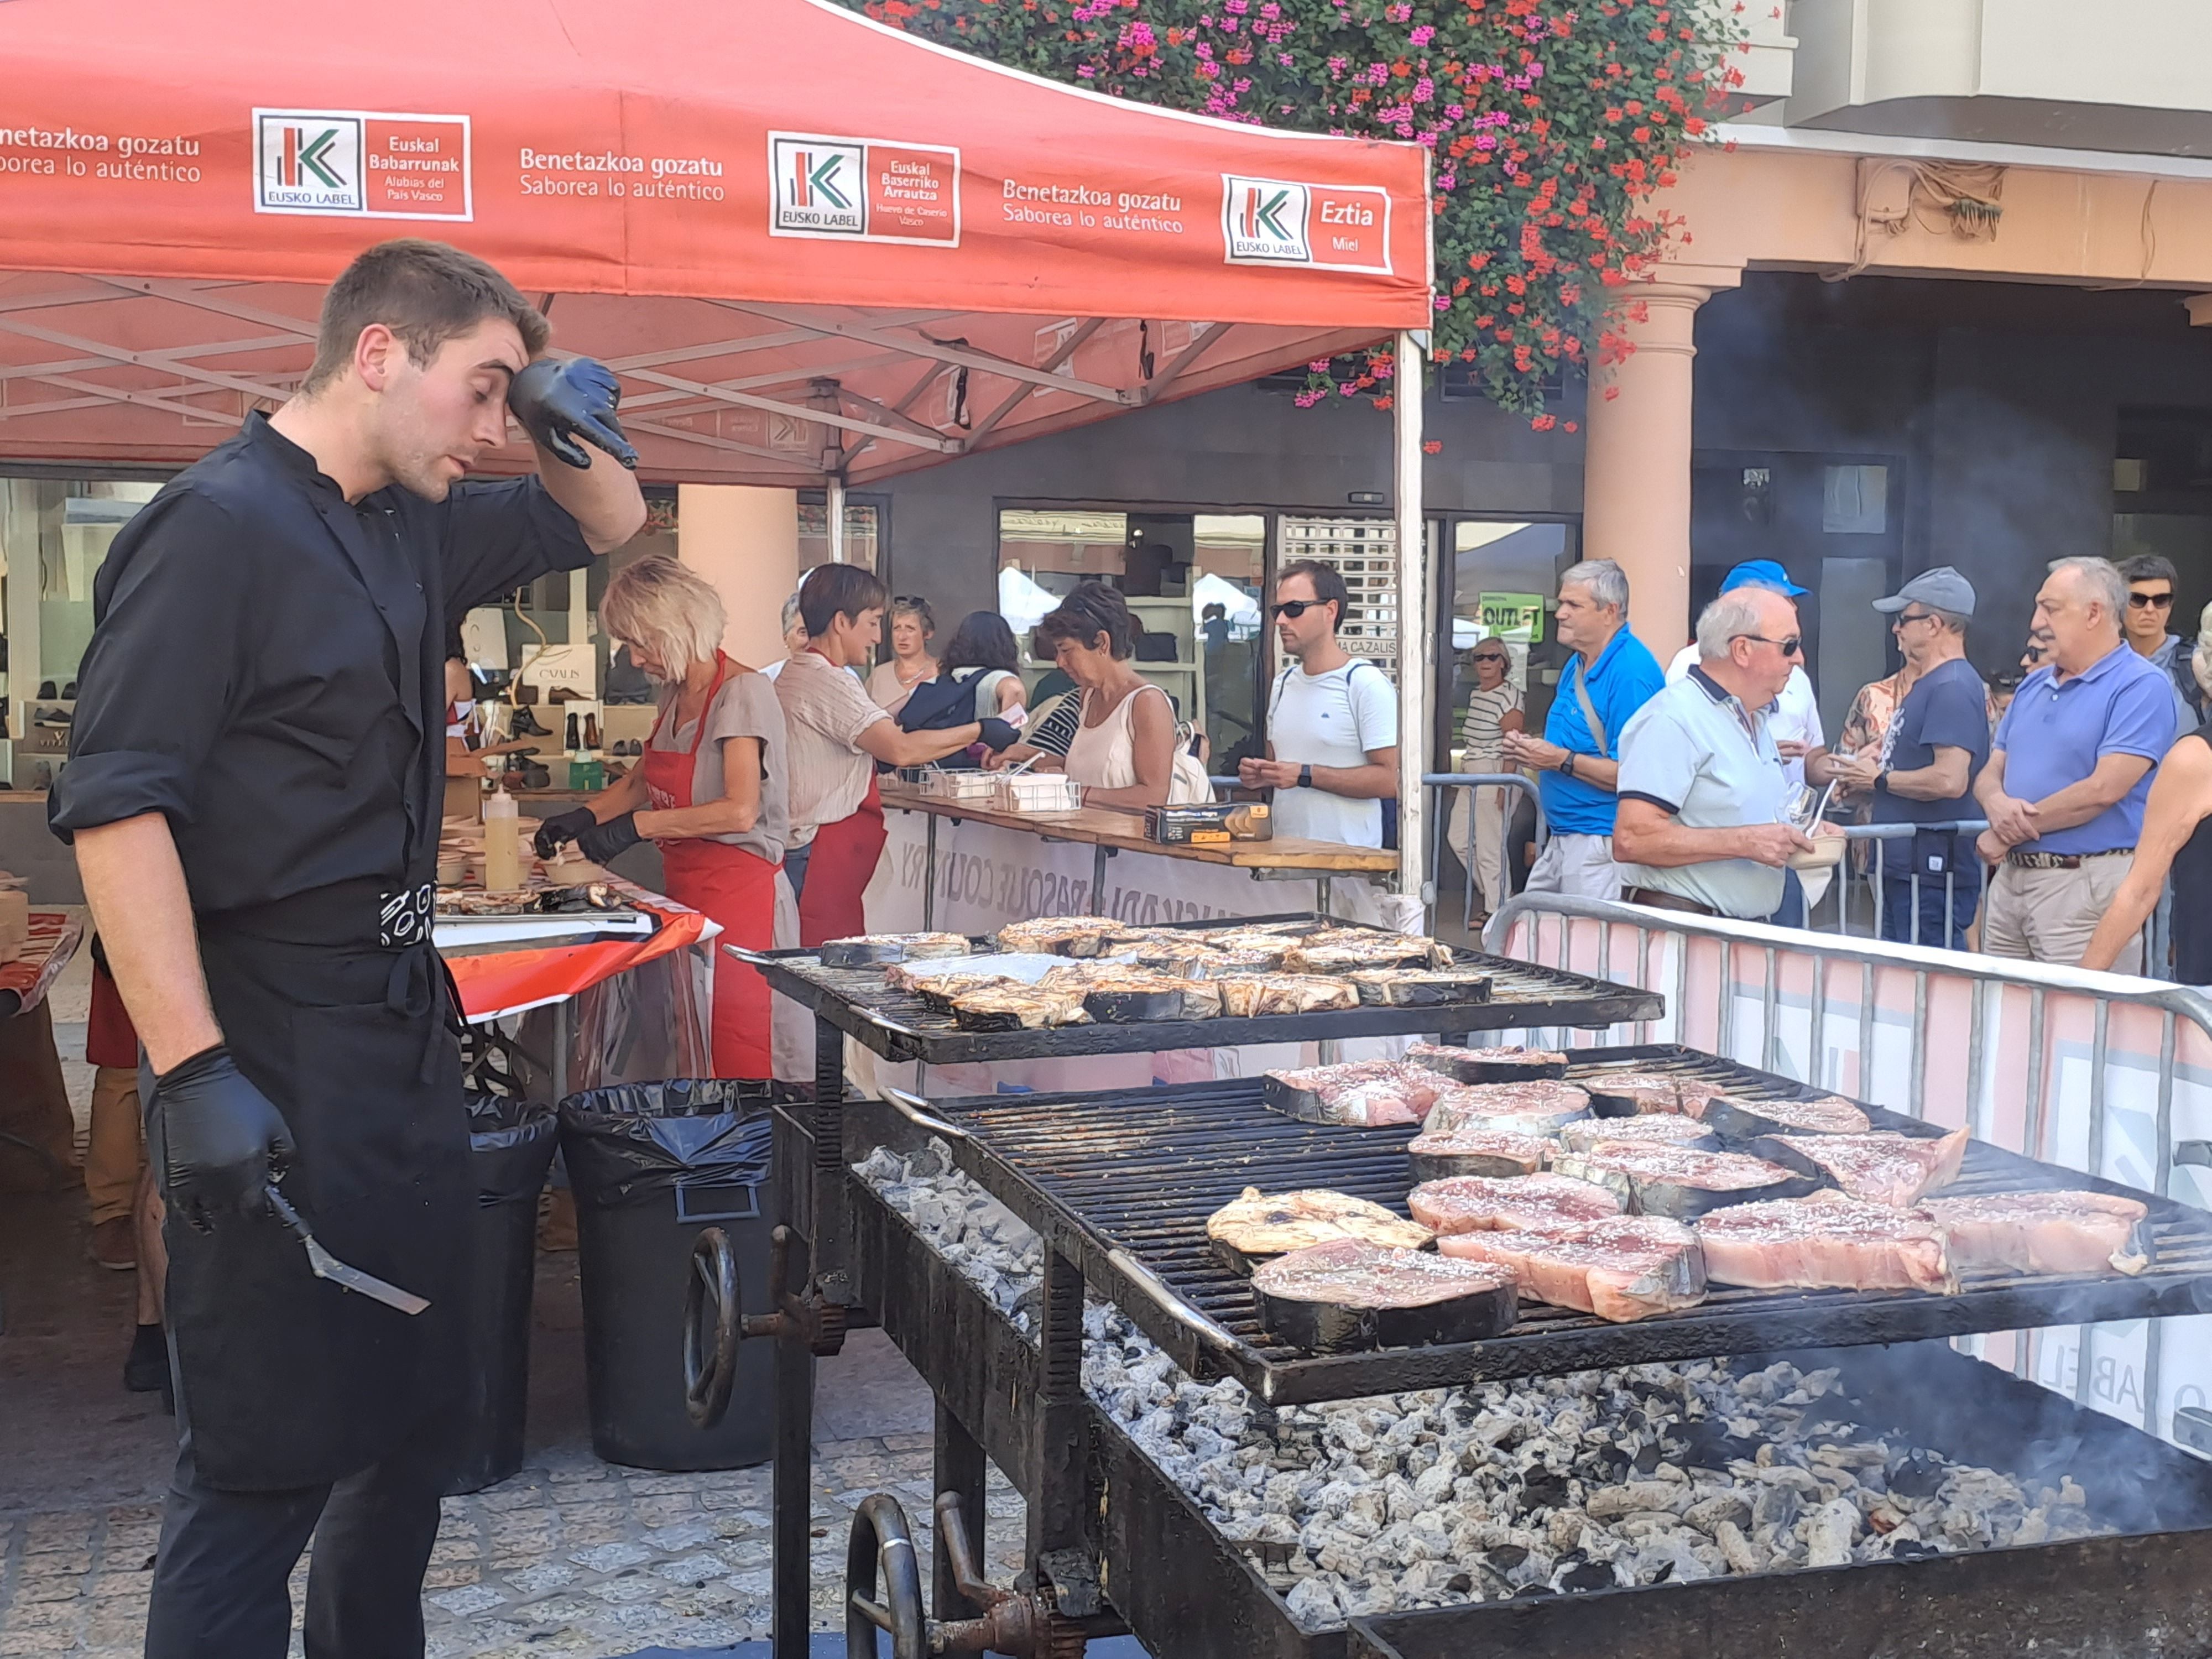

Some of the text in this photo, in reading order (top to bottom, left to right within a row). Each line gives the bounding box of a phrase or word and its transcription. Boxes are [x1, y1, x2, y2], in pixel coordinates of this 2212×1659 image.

[118, 135, 200, 159] gozatu
[389, 136, 439, 153] Euskal
[66, 155, 86, 176] lo
[96, 159, 201, 182] auténtico
[369, 154, 460, 173] Babarrunak
[520, 148, 723, 179] Benetazkoa gozatu
[890, 160, 930, 176] Euskal
[384, 175, 445, 189] Alubias del
[520, 174, 724, 202] Saborea lo auténtico
[881, 173, 940, 189] Baserriko
[269, 191, 356, 206] EUSKO LABEL
[412, 191, 444, 202] Vasco
[883, 186, 937, 201] Arrautza
[1003, 178, 1181, 213] Benetazkoa gozatu
[782, 211, 859, 227] EUSKO LABEL
[1002, 202, 1184, 234] Saborea lo auténtico
[1320, 200, 1374, 227] Eztia
[1236, 241, 1303, 255] EUSKO LABEL
[1331, 236, 1359, 252] Miel
[1350, 641, 1396, 654] CAZALIS
